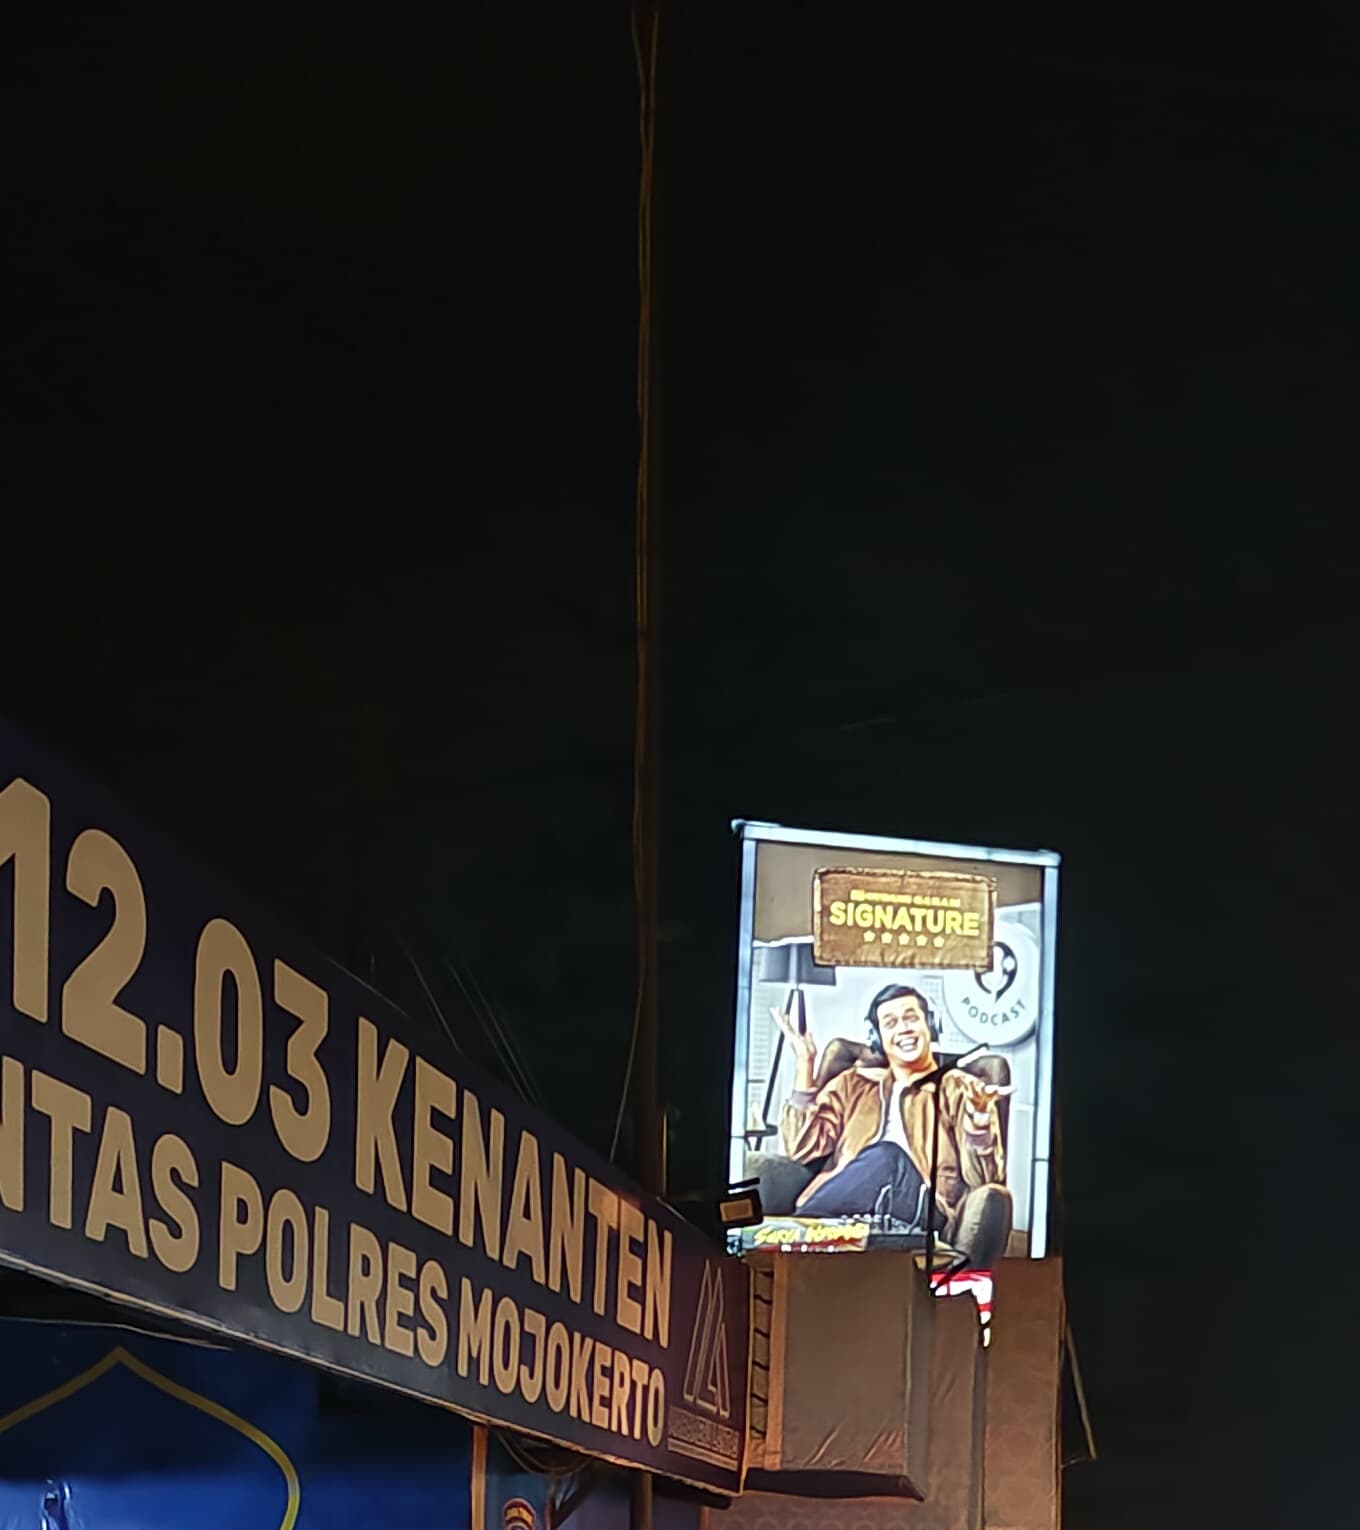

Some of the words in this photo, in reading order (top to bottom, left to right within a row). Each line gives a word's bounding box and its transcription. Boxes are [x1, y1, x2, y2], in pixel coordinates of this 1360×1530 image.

[828, 900, 980, 937] SIGNATURE
[960, 996, 1027, 1027] PODCAST
[354, 1016, 673, 1349] KENANTEN
[219, 1161, 448, 1368] POLRES
[457, 1276, 665, 1448] MOJOKERTO
